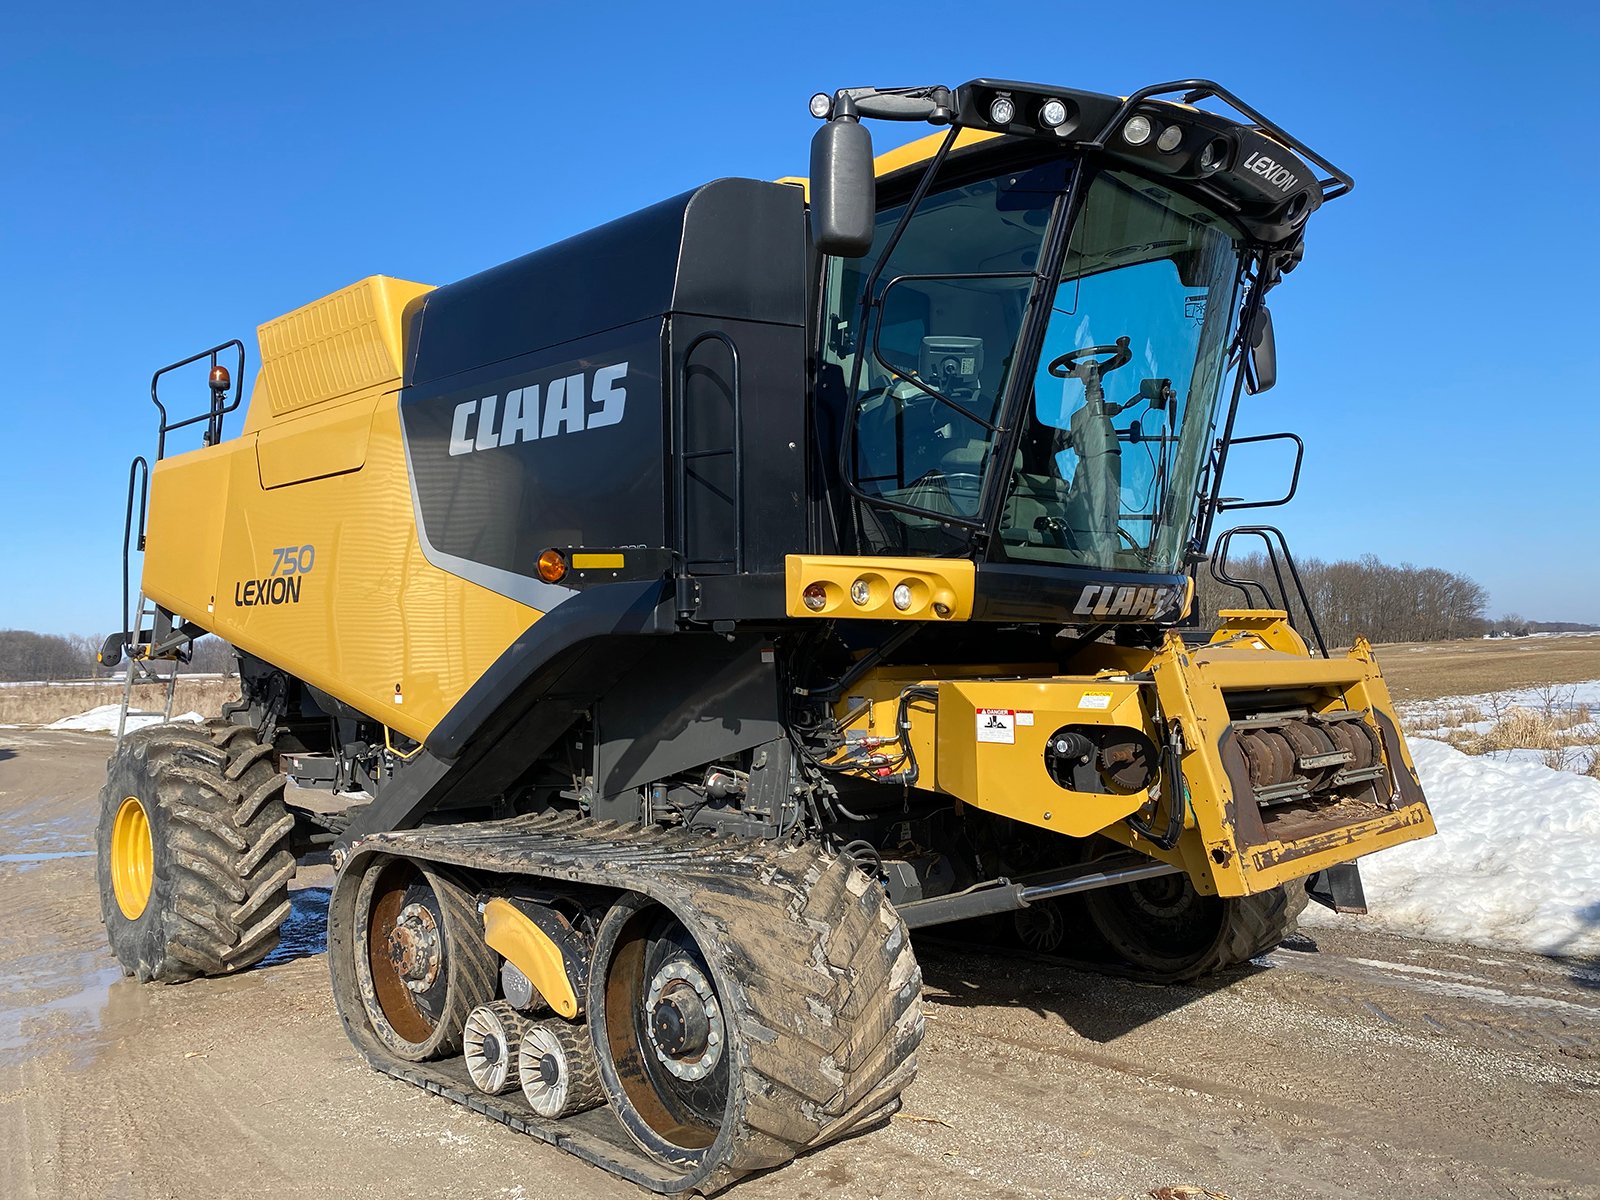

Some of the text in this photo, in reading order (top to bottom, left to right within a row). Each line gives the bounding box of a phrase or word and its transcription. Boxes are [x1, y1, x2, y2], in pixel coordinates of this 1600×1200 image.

[1243, 151, 1299, 192] LEXION
[449, 361, 629, 457] CLAAS
[270, 544, 315, 577] 750
[234, 575, 302, 607] LEXION
[1072, 585, 1169, 617] CLAAS
